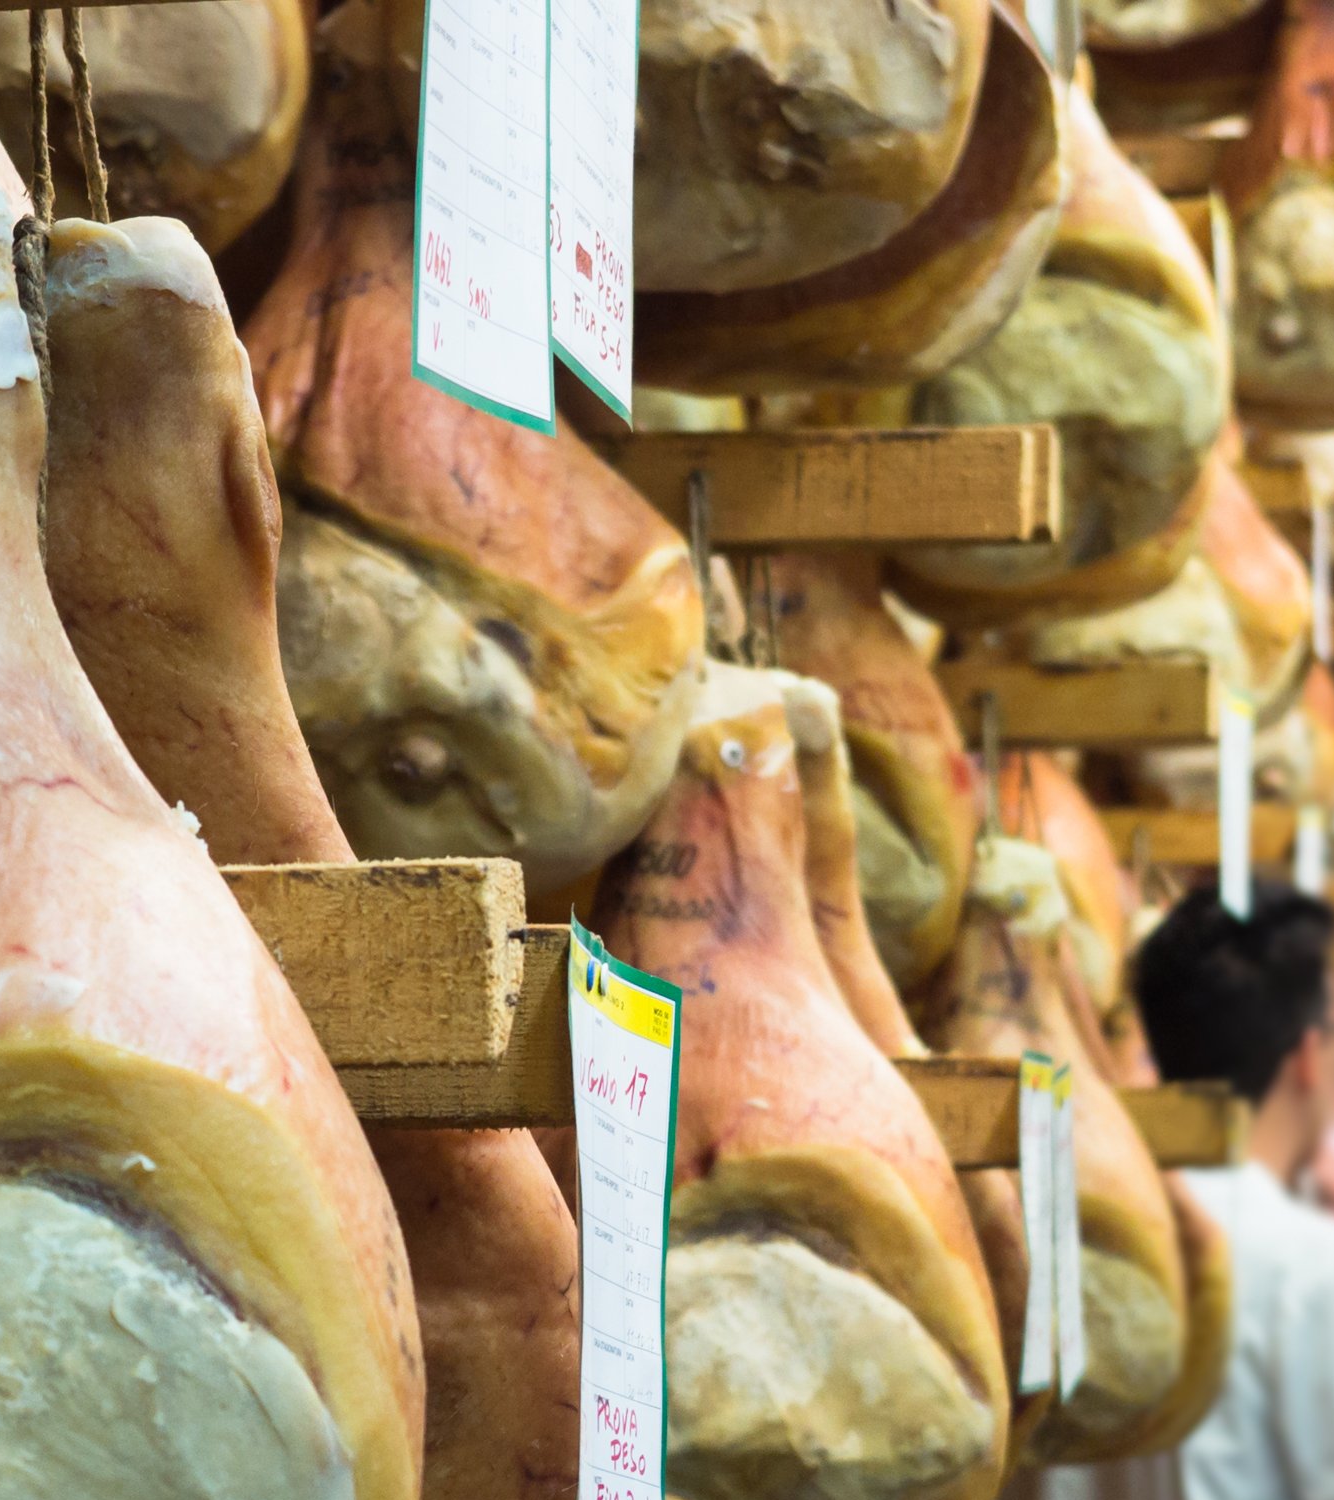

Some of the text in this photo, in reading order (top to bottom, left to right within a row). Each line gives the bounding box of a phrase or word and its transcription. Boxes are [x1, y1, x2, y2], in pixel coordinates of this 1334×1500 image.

[596, 230, 624, 288] PROVA
[598, 271, 624, 323] PESO
[596, 1394, 638, 1437] PROVA
[610, 1439, 646, 1476] PESO
